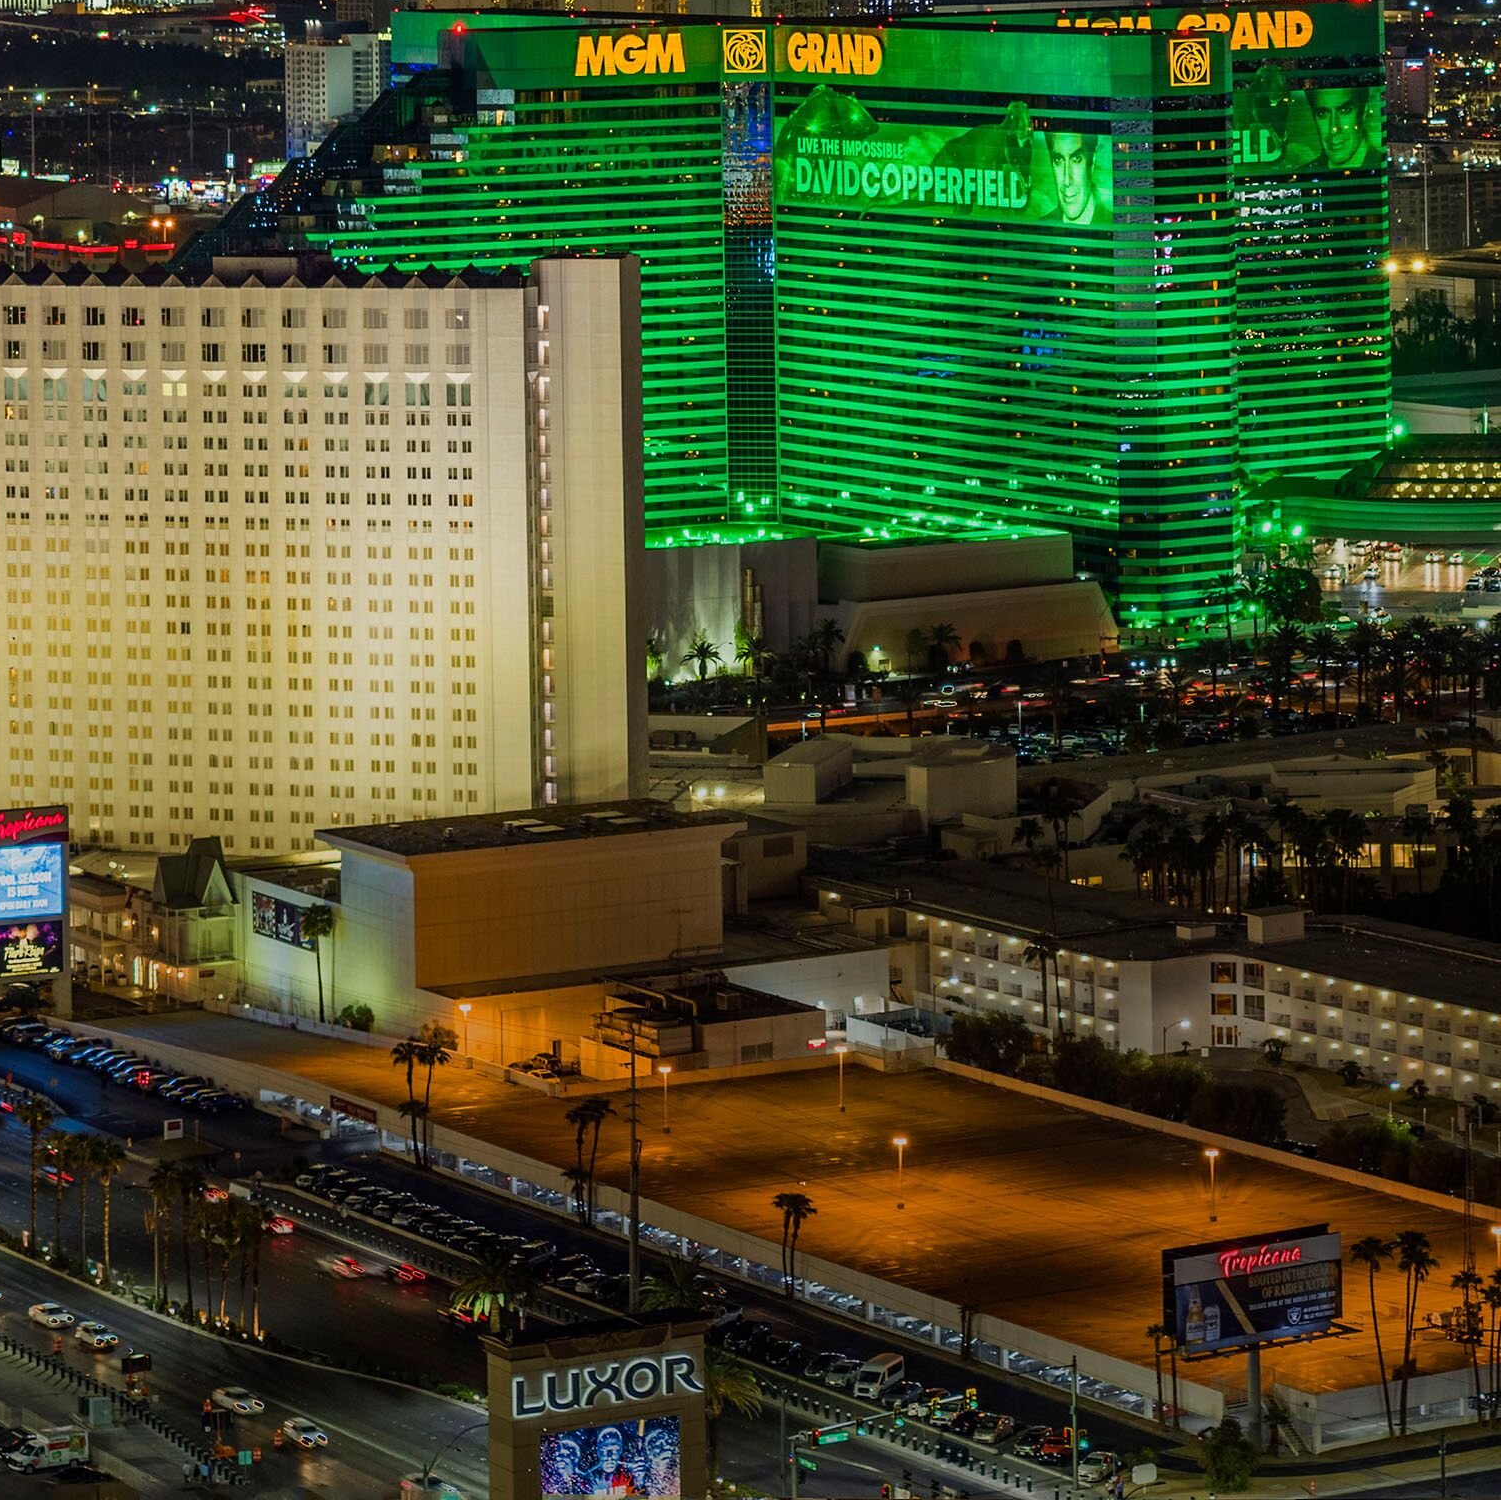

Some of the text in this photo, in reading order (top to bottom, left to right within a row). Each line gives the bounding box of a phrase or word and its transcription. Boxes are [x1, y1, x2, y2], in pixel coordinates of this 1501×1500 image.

[574, 31, 884, 77] MGM GRAND
[797, 137, 904, 160] LIVE THE IMPOSSIBLE
[17, 871, 52, 885] SEASON
[7, 884, 39, 898] IS HERE
[1219, 1244, 1302, 1279] Tropicana
[1262, 1276, 1336, 1299] OF RAIDER NATION
[512, 1354, 705, 1420] LUXOR
